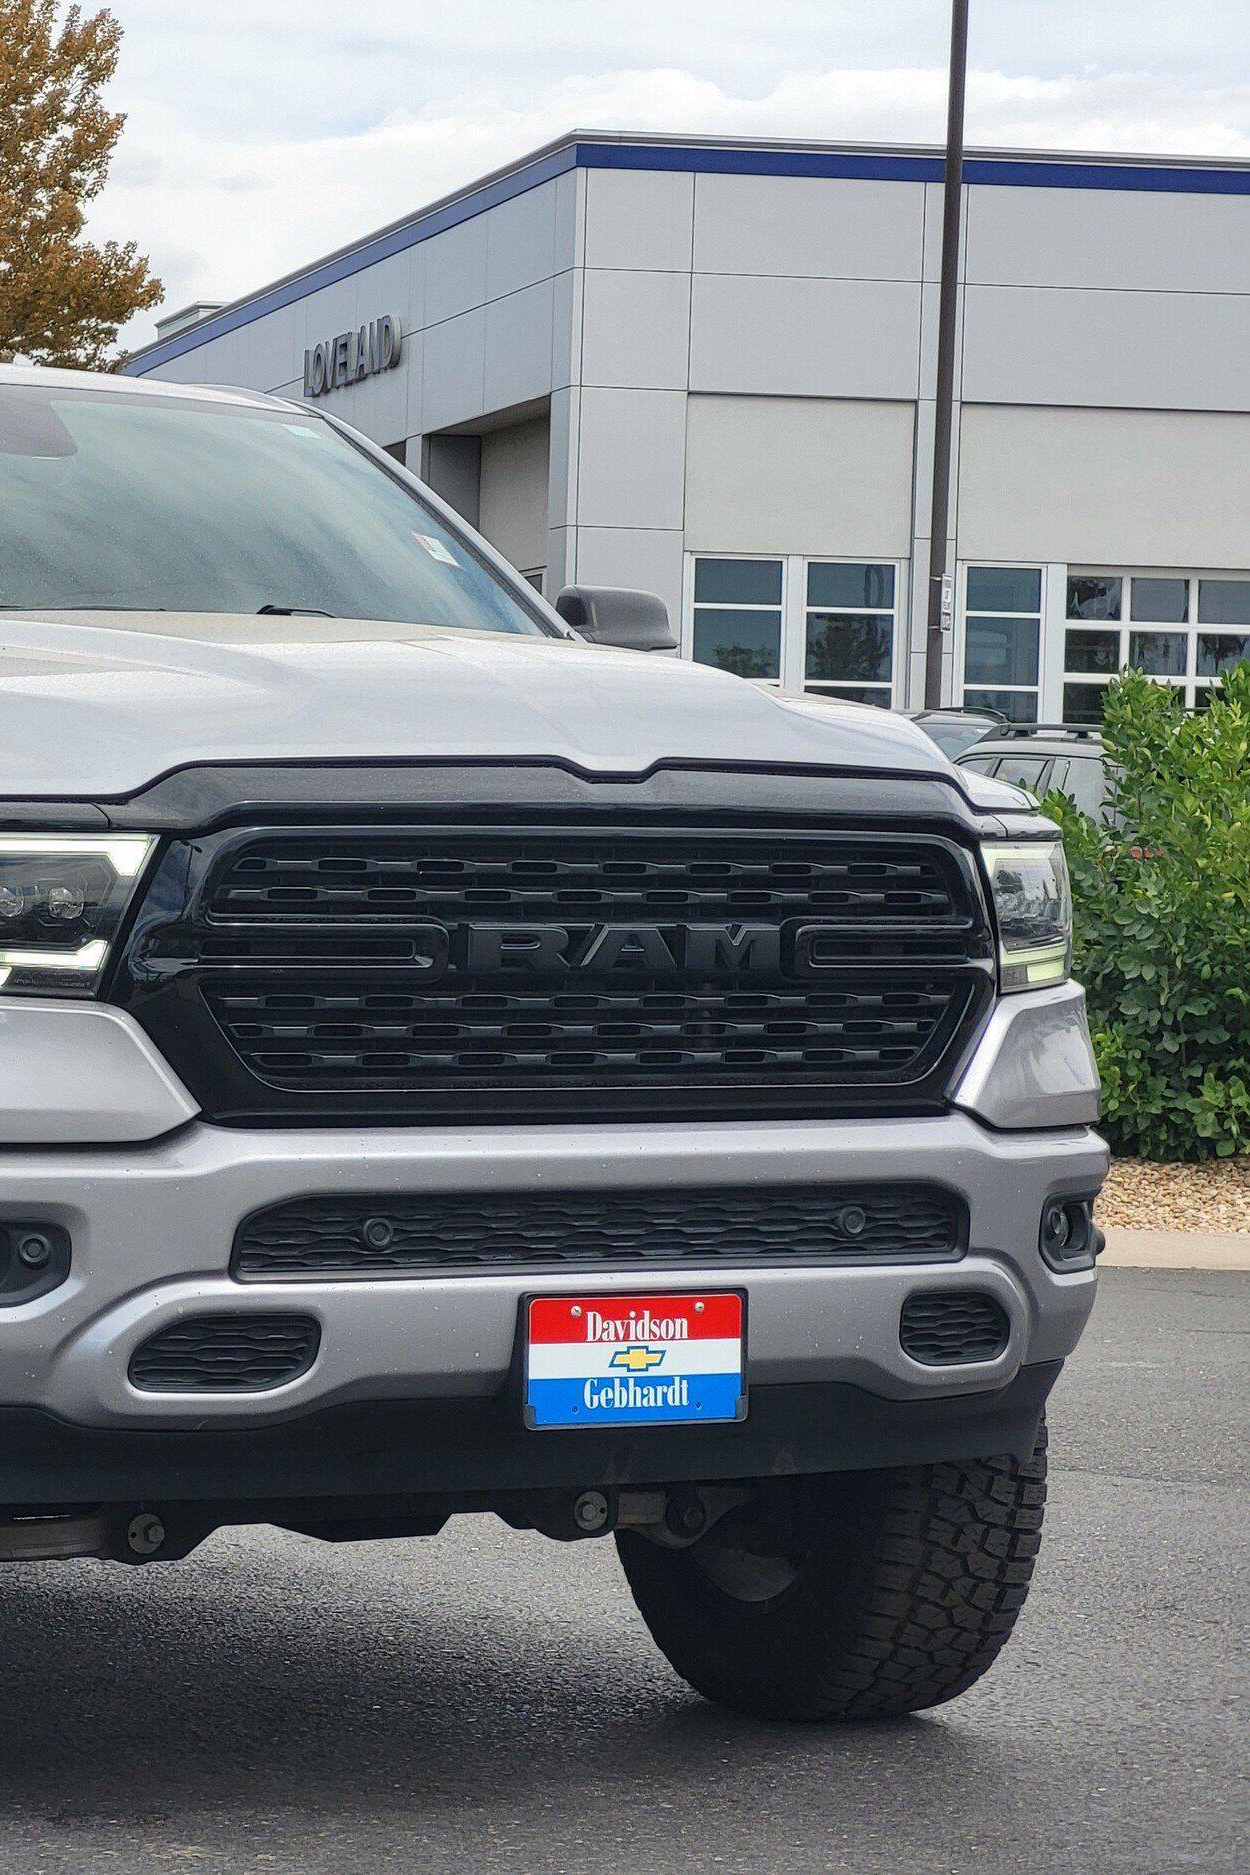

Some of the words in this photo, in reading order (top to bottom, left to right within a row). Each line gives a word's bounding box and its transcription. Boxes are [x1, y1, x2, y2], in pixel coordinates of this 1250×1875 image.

[303, 315, 401, 398] LOVELAND
[467, 922, 781, 970] RAM
[585, 1310, 690, 1342] Davidson
[583, 1376, 690, 1410] Gebhardt
